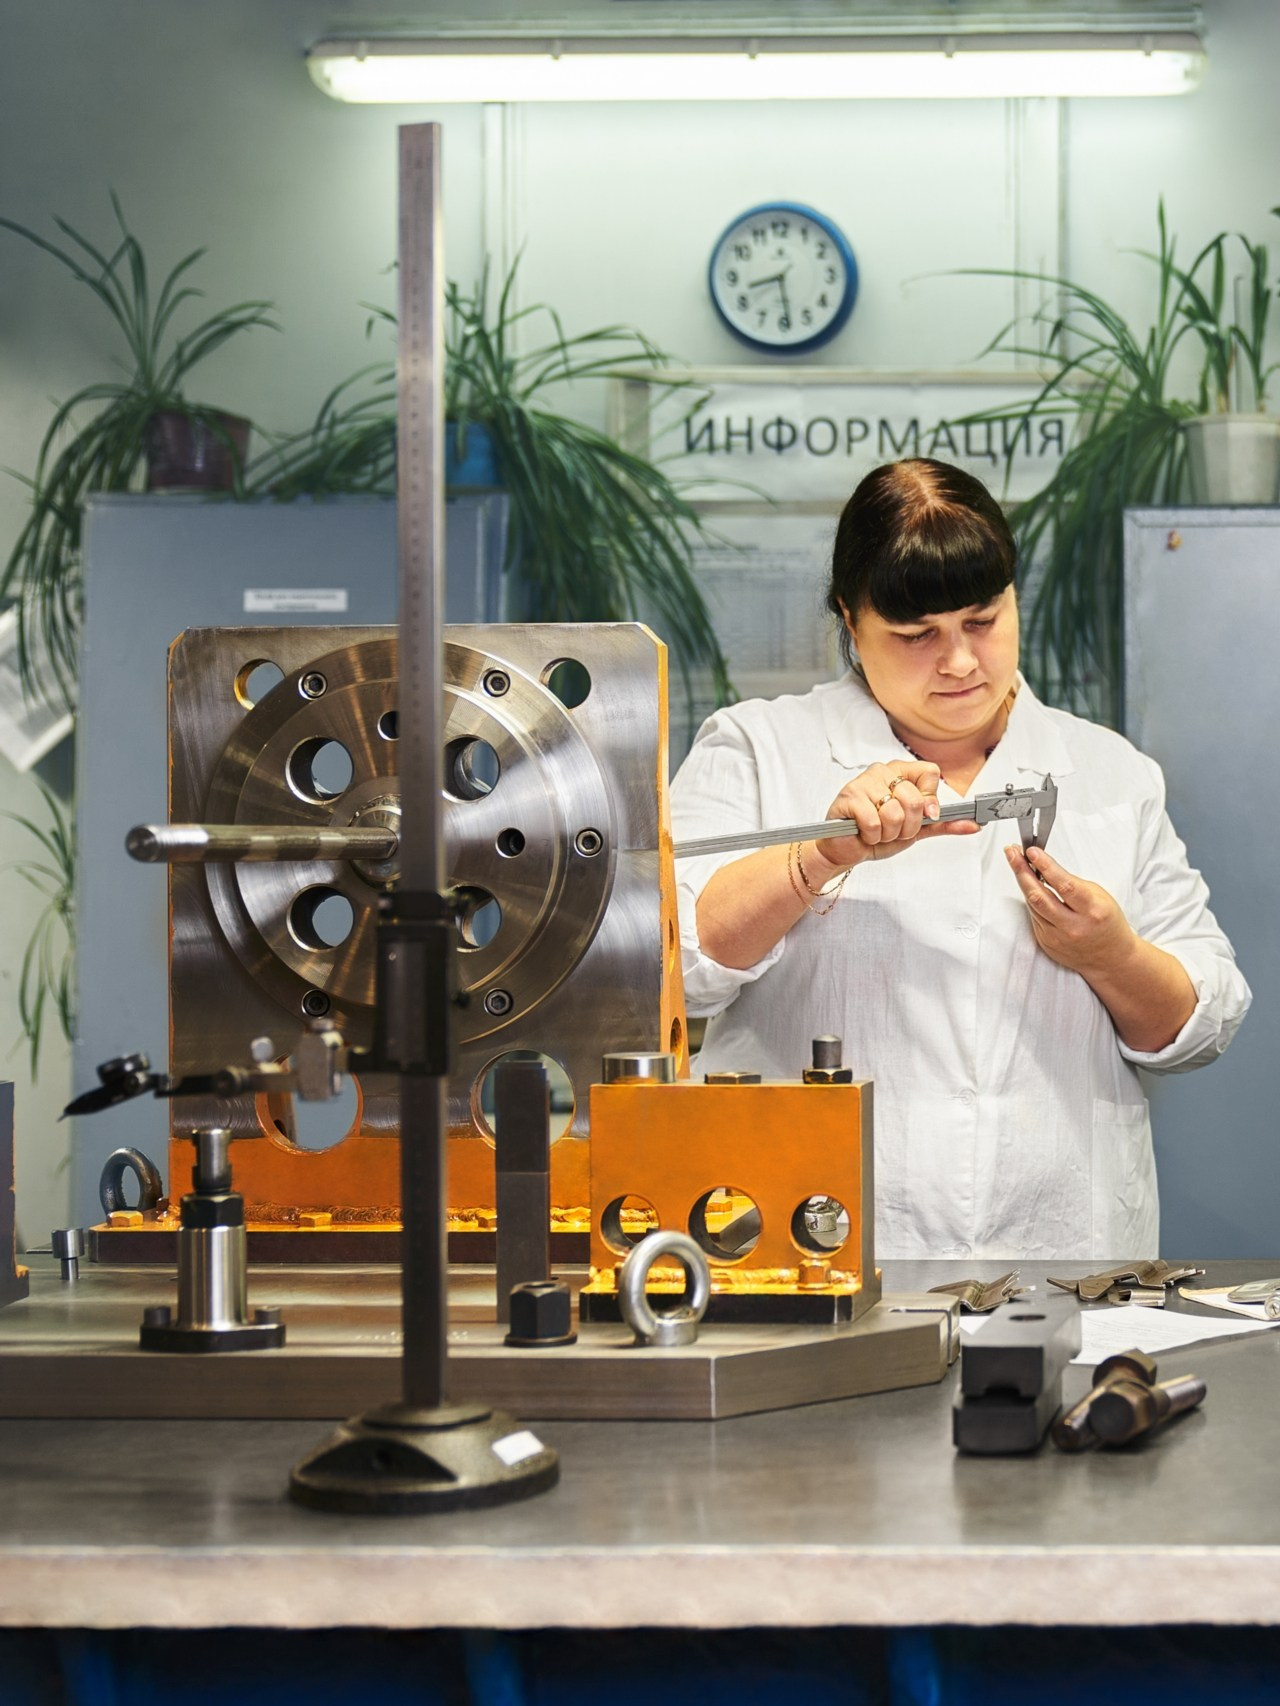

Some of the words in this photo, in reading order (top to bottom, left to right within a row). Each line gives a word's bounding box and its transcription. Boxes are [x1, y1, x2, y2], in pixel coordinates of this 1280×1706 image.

[752, 227, 767, 245] 11
[771, 220, 790, 238] 12
[801, 225, 809, 244] 1
[733, 243, 752, 262] 10
[817, 241, 827, 260] 2
[726, 269, 739, 288] 9
[824, 267, 836, 284] 3
[737, 294, 749, 312] 8
[816, 294, 828, 309] 4
[756, 308, 768, 329] 7
[801, 308, 812, 326] 5
[684, 416, 1065, 467] ИНФОРМАЦИЯ
